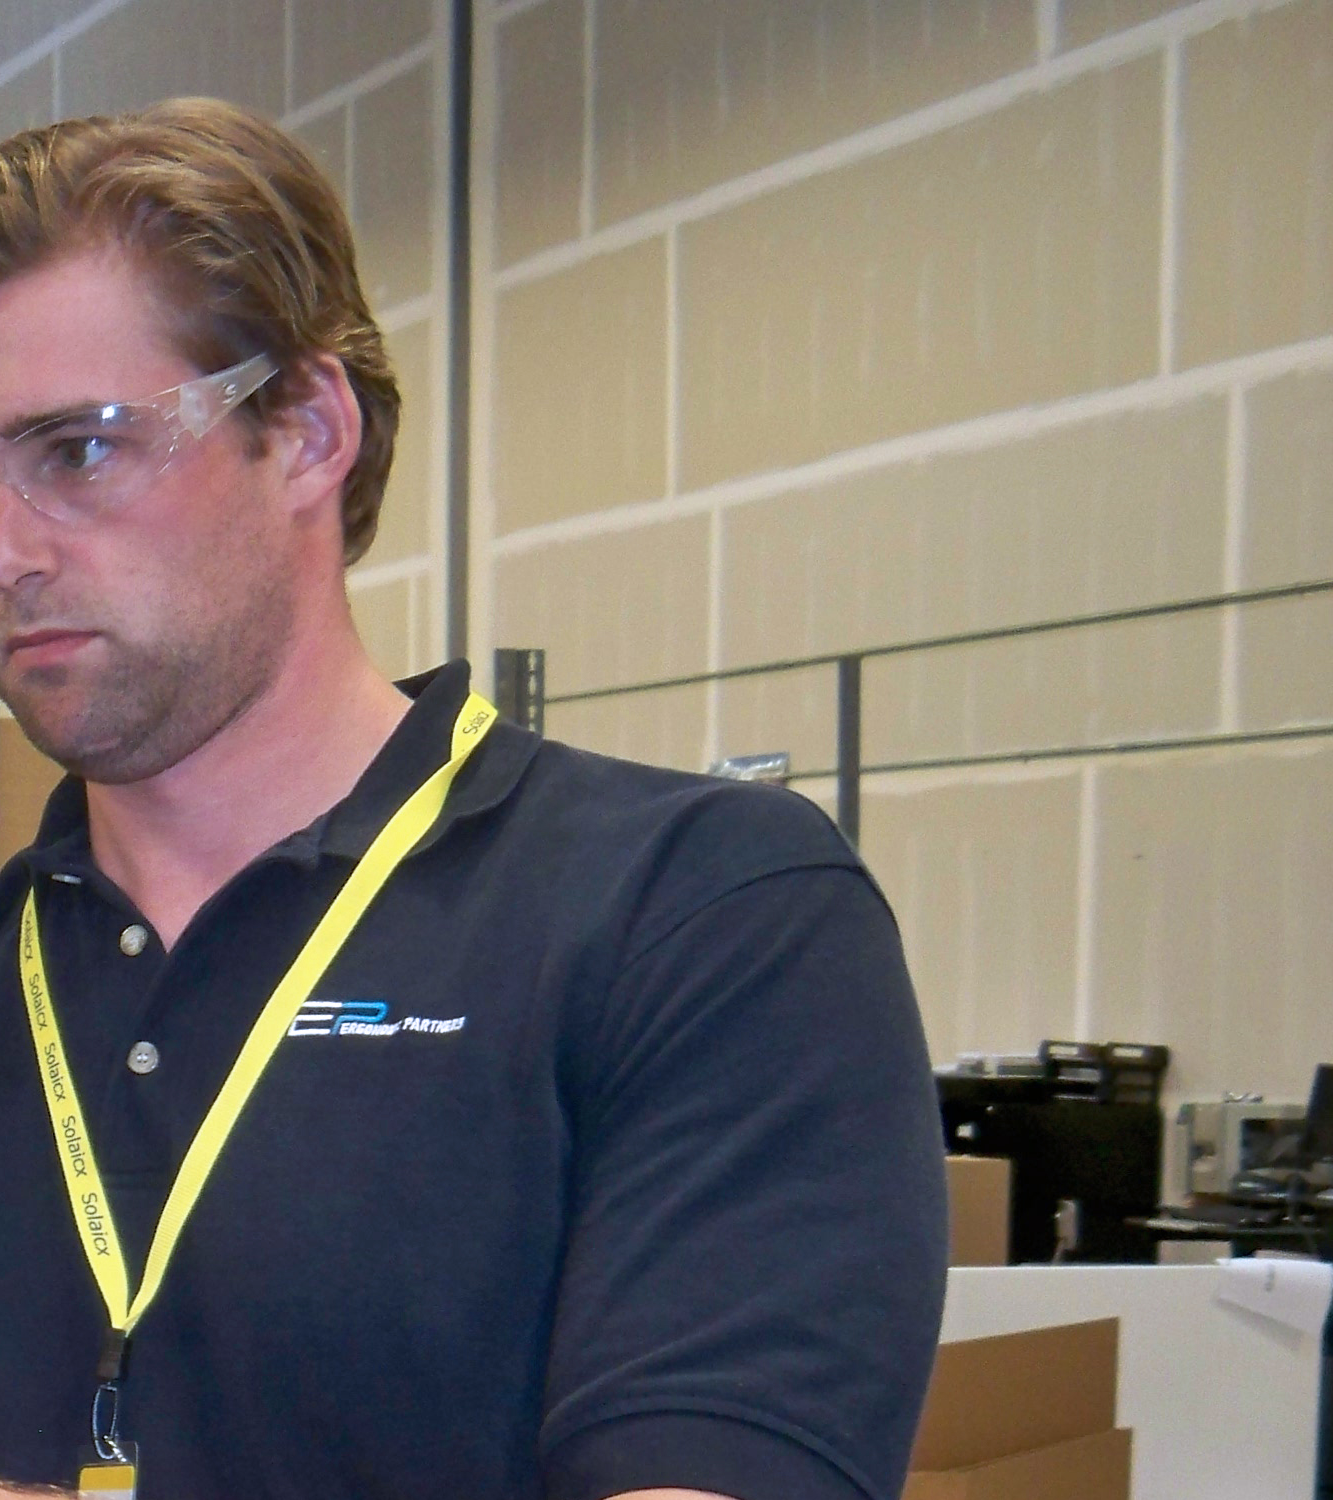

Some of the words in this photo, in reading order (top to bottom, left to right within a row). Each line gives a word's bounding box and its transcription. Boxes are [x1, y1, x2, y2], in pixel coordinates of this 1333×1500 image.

[44, 1042, 66, 1102] Solaicx
[61, 1115, 88, 1177] Solaicx
[81, 1192, 110, 1256] Solaicx
